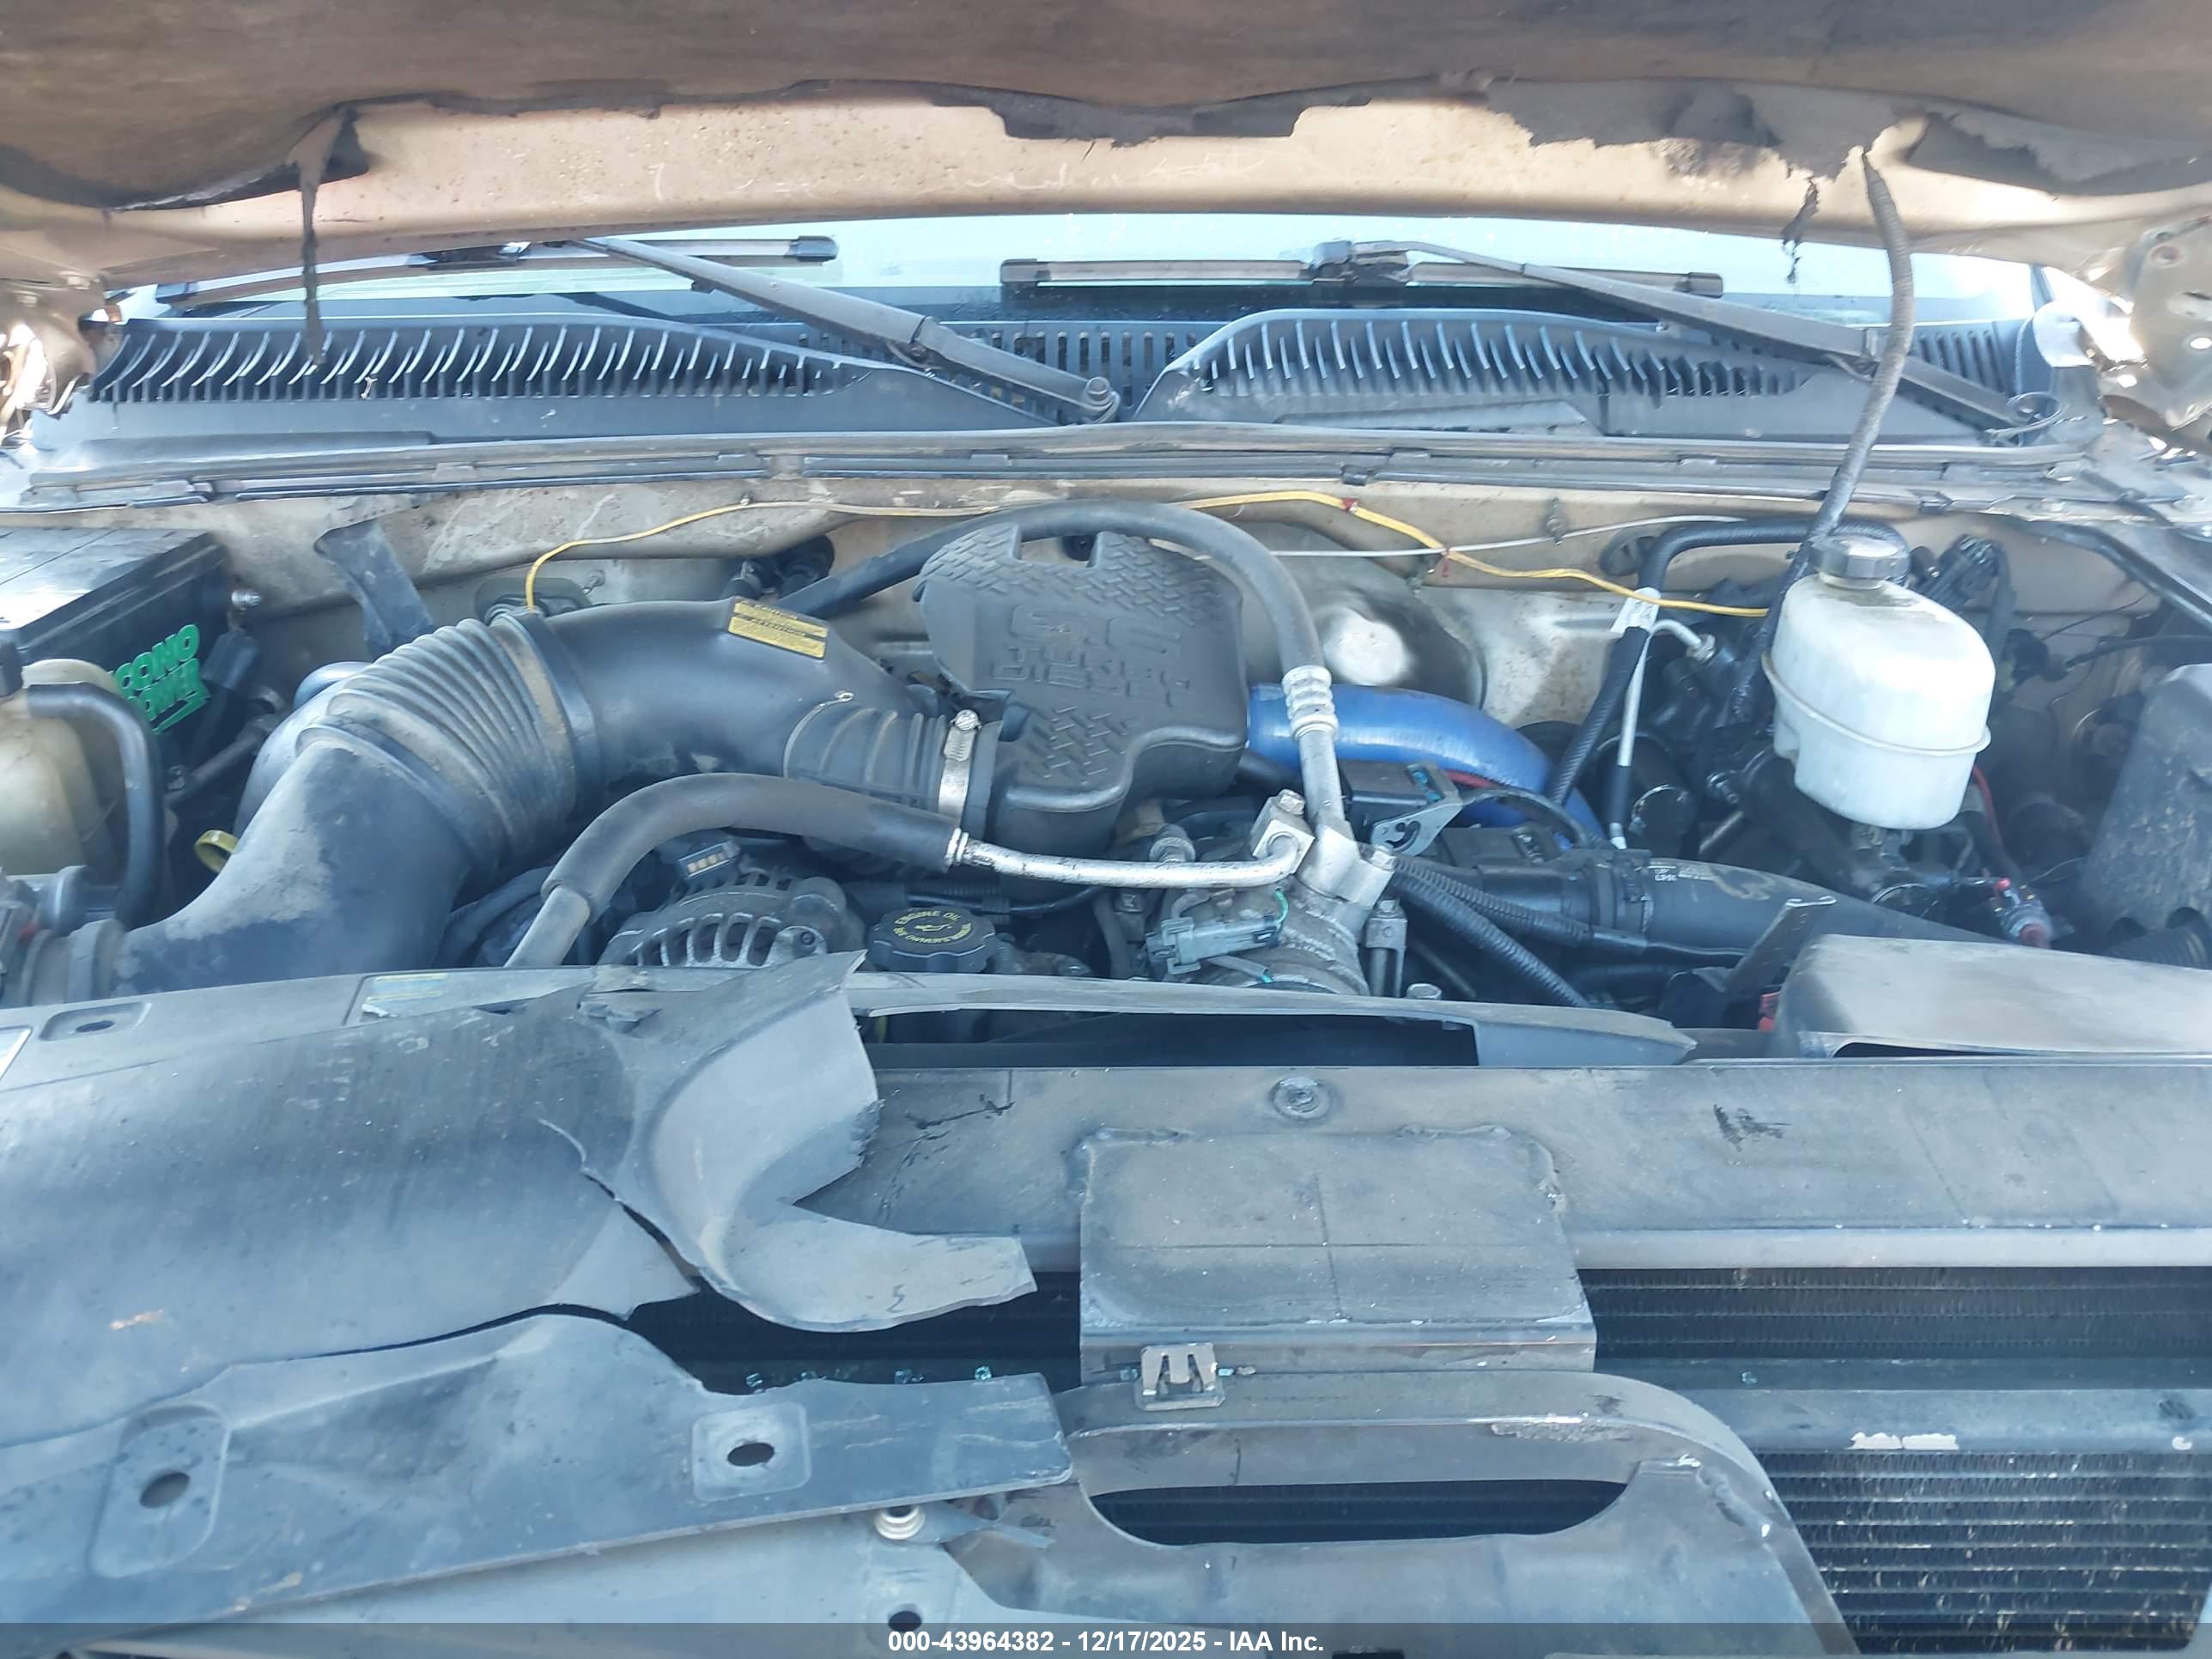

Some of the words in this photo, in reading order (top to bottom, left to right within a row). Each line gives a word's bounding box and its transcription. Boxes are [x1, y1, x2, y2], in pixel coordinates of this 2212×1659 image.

[112, 623, 201, 698] CONO
[127, 658, 203, 722] OWER
[942, 912, 963, 921] OIL
